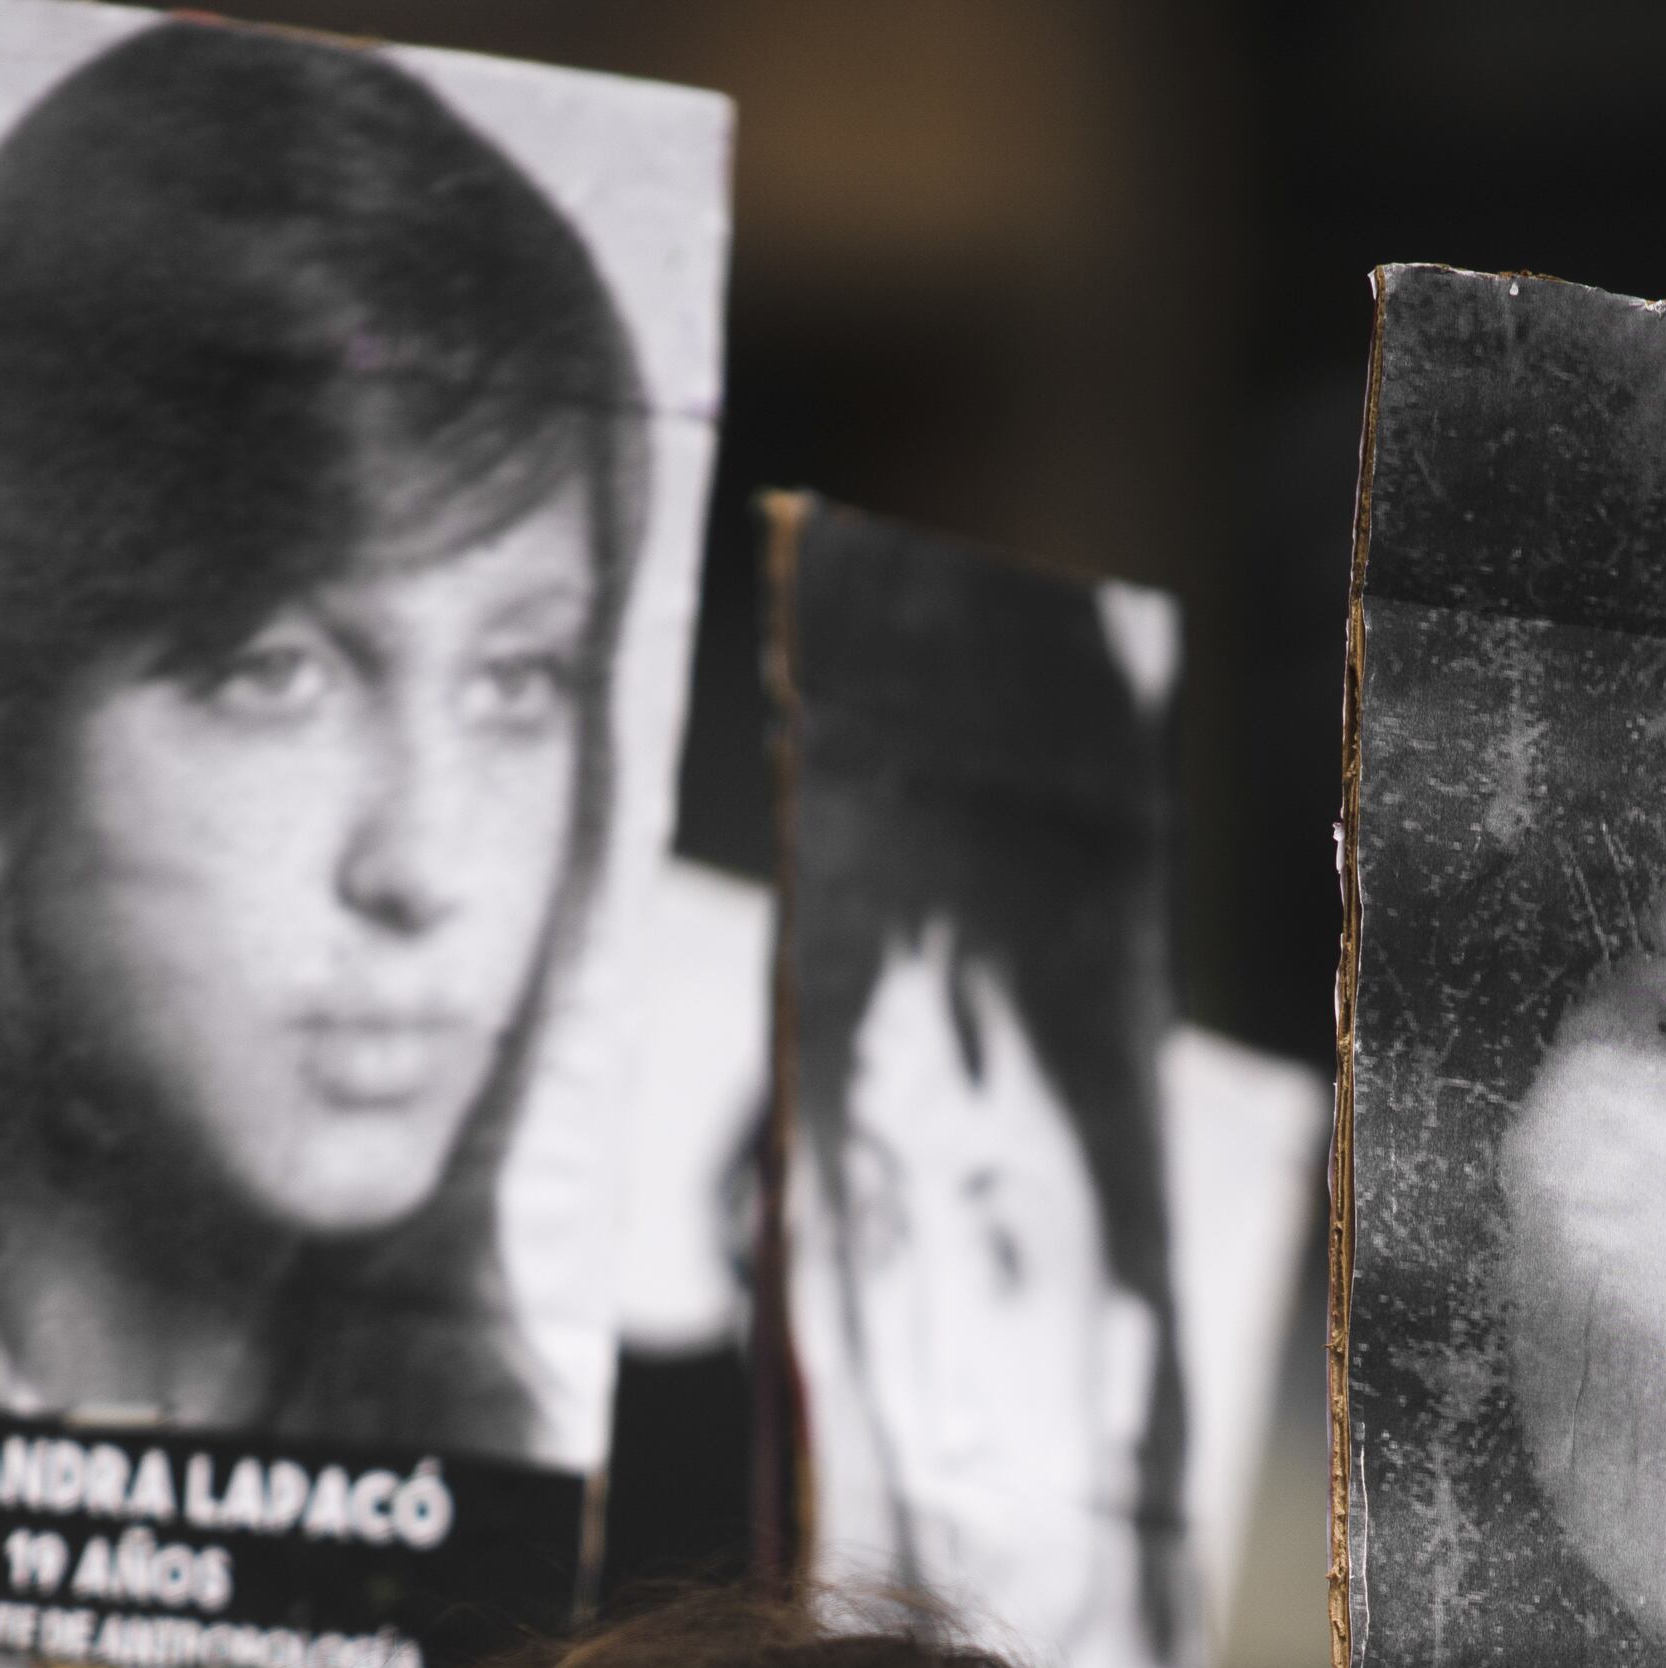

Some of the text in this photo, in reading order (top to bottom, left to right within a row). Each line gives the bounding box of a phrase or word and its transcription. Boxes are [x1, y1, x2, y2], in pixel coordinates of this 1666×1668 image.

[185, 1452, 453, 1549] LAPACÓ
[4, 1525, 232, 1609] 19 AÑOS
[40, 1607, 96, 1657] DE
